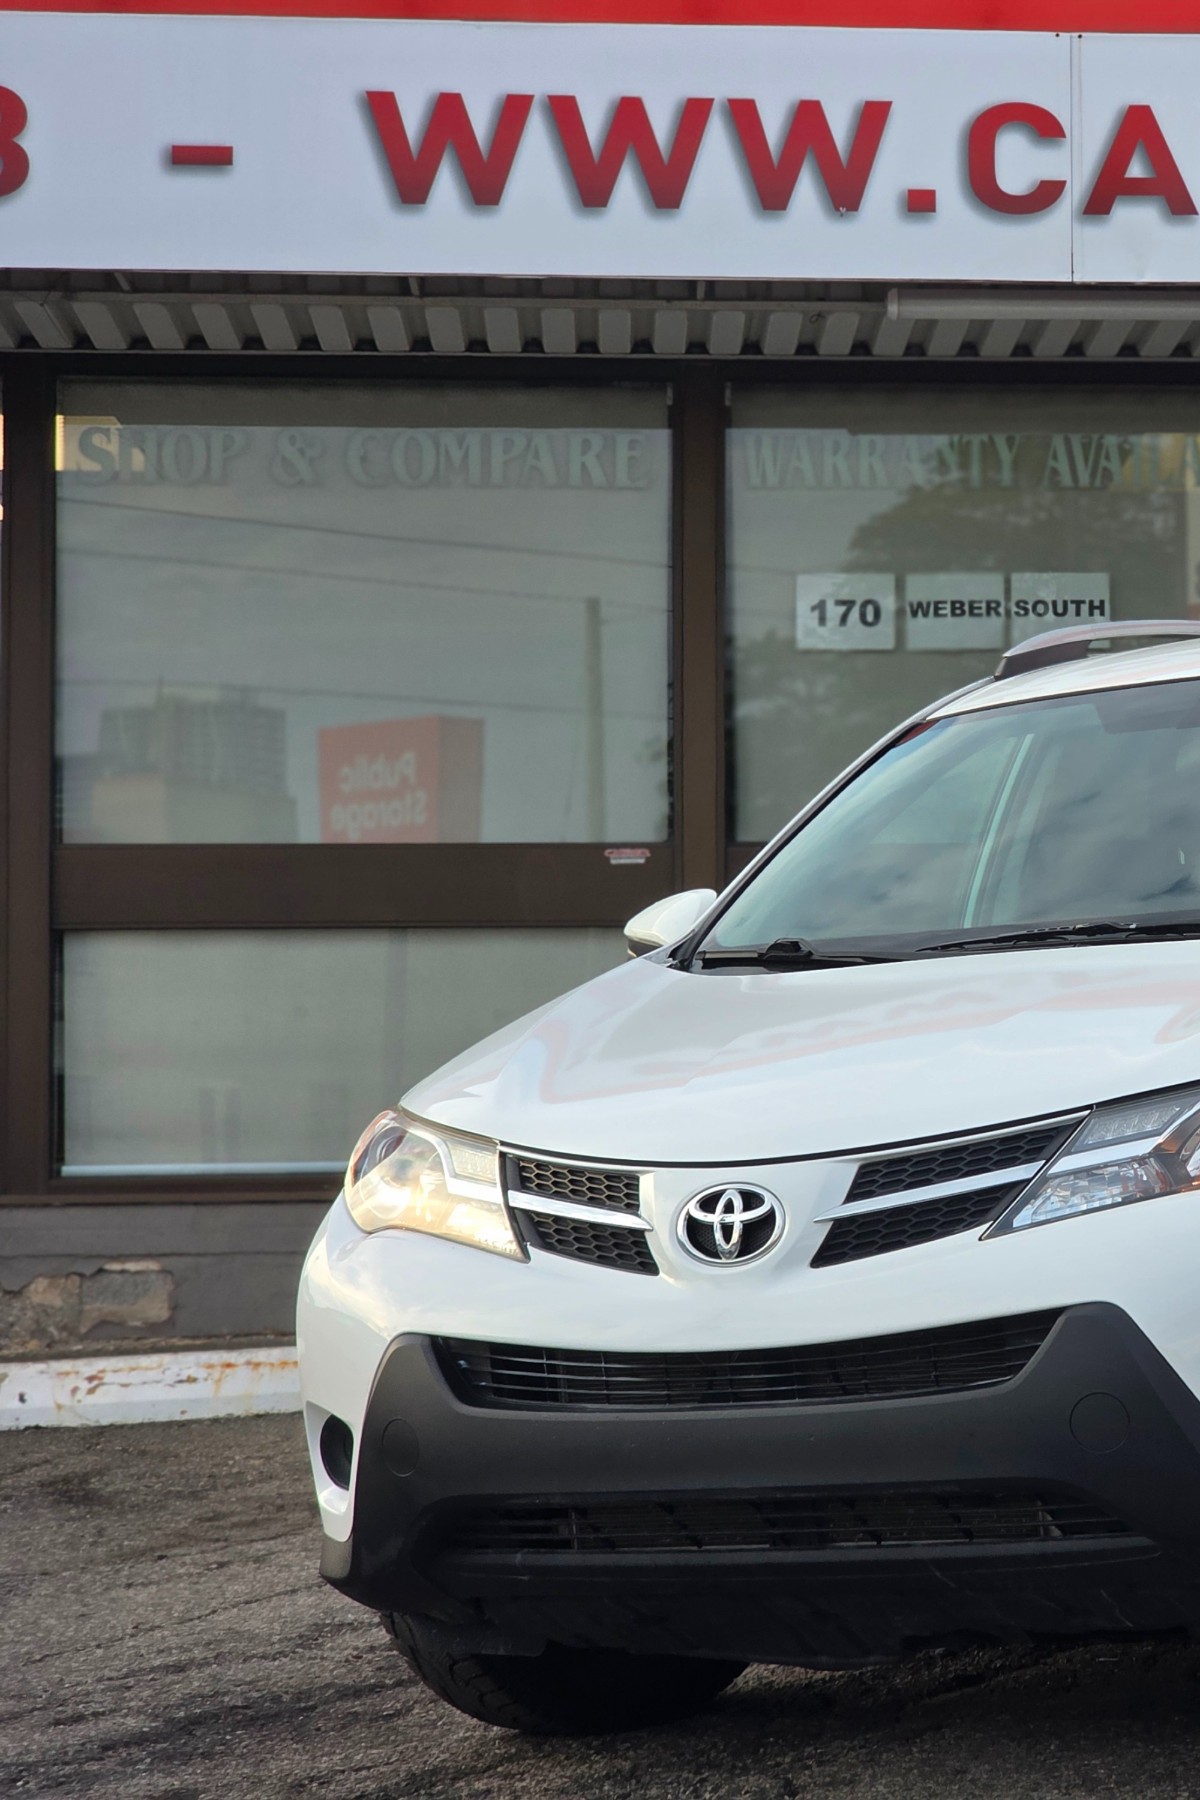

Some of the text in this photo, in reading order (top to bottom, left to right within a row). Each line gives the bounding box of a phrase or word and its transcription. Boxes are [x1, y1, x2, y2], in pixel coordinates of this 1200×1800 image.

[78, 425, 240, 486] SHOP
[347, 429, 650, 488] COMPARE
[746, 434, 1020, 488] WARRANTY
[809, 600, 882, 628] 170
[908, 600, 1106, 619] WEBER SOUTH
